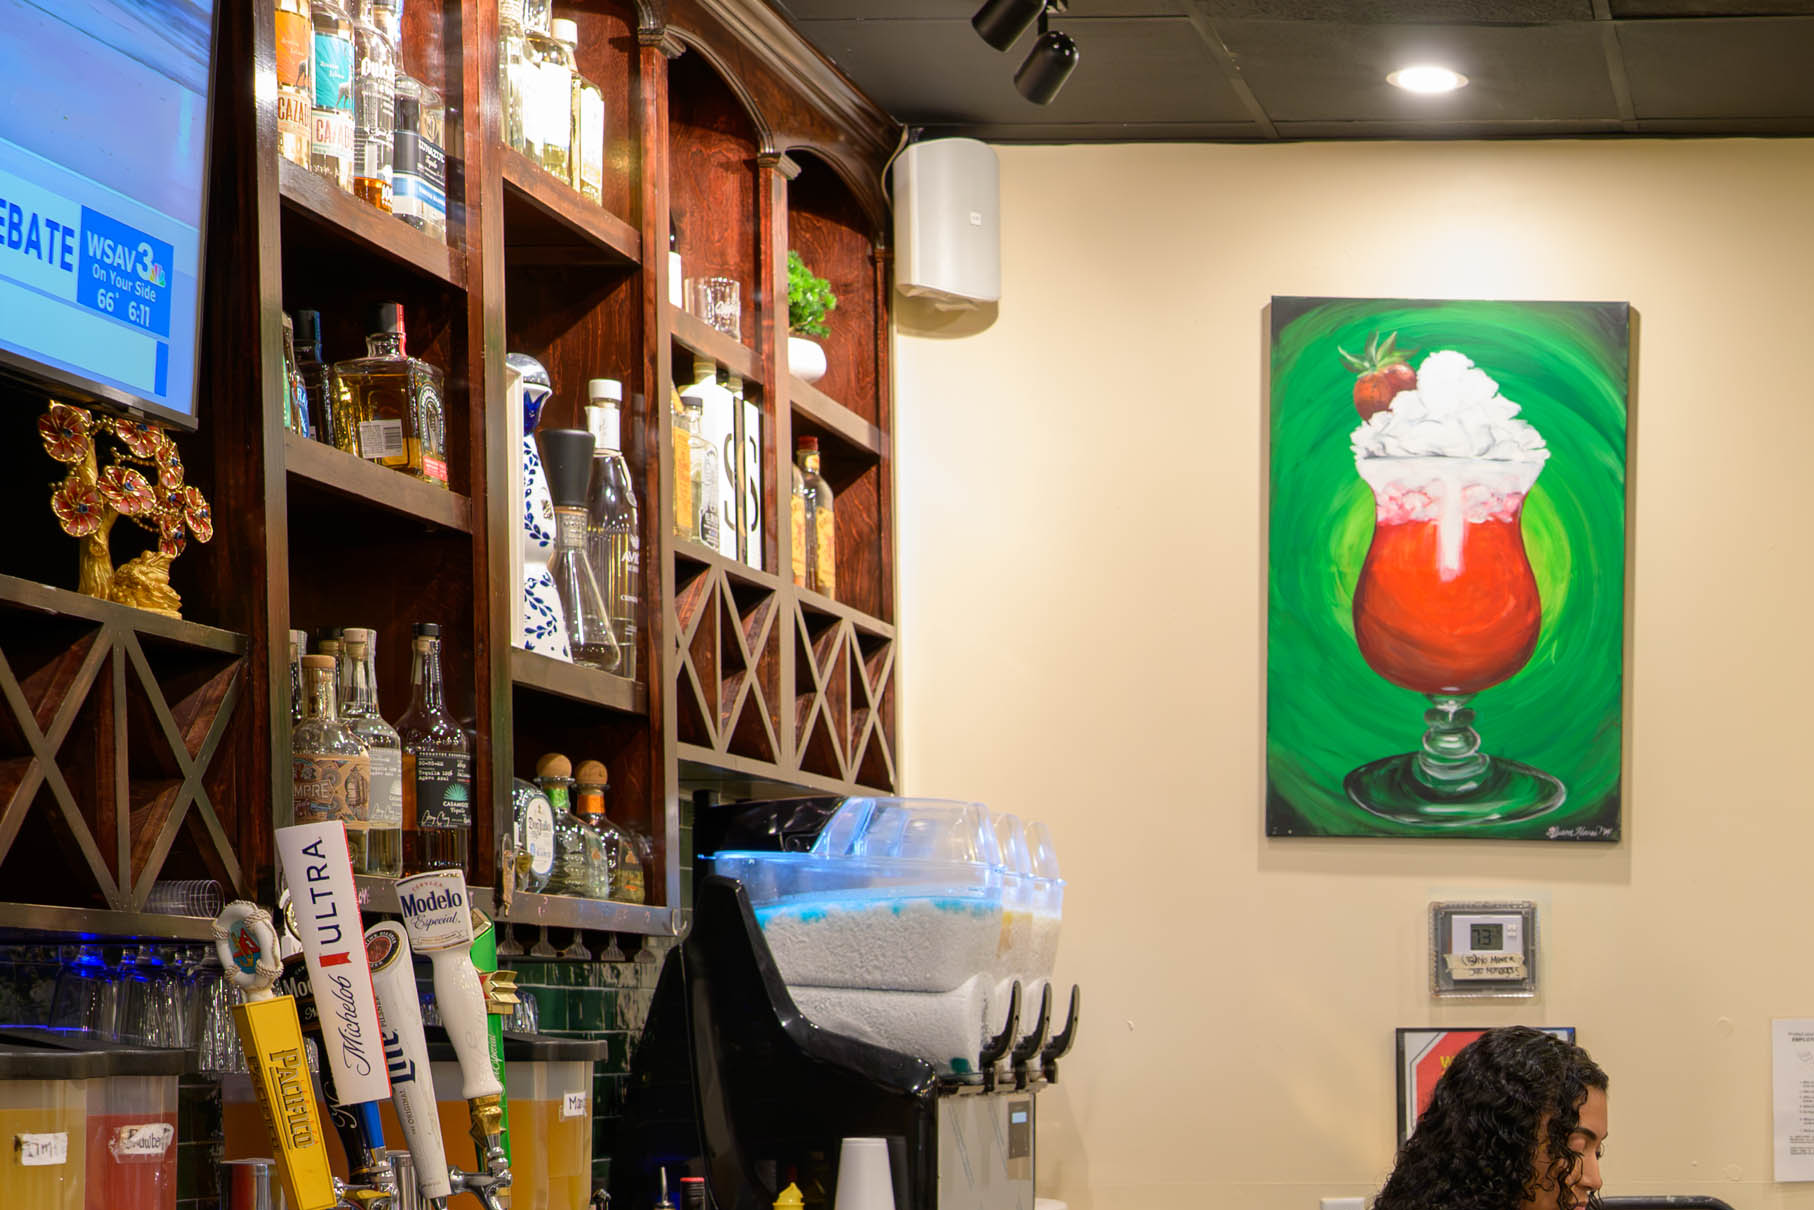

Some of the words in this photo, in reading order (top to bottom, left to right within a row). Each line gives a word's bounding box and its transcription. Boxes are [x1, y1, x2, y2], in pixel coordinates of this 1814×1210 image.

[87, 231, 136, 272] WSAV
[136, 241, 154, 281] 3
[92, 264, 107, 283] On
[109, 270, 133, 292] Your
[135, 280, 157, 303] Side
[128, 301, 151, 327] 6:11
[302, 838, 343, 945] ULTRA
[400, 888, 462, 918] Modelo
[328, 974, 371, 1077] Michelob
[269, 1047, 314, 1149] PACIFICO
